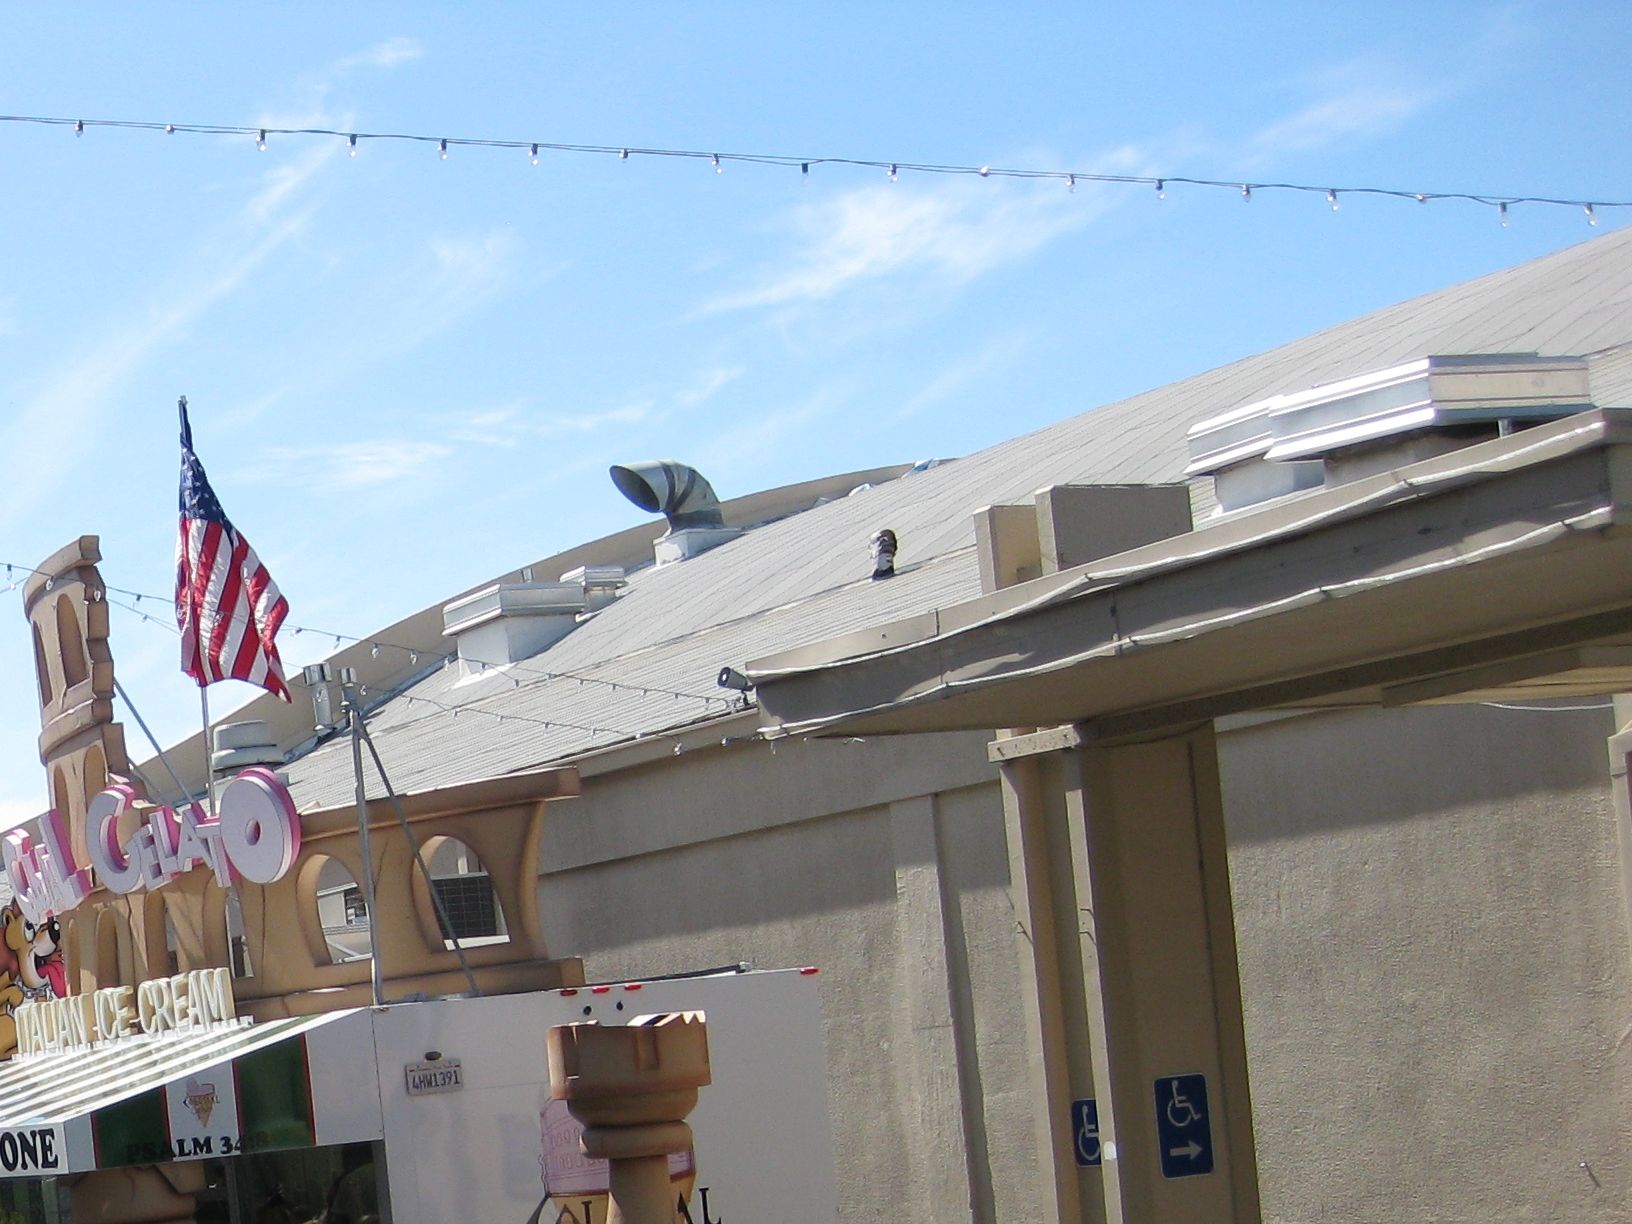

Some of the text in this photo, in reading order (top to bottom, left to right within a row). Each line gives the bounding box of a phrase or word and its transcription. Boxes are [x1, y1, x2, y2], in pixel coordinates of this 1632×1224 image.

[86, 768, 301, 895] GELATO
[14, 967, 236, 1055] ITALIAN ICE CREAM
